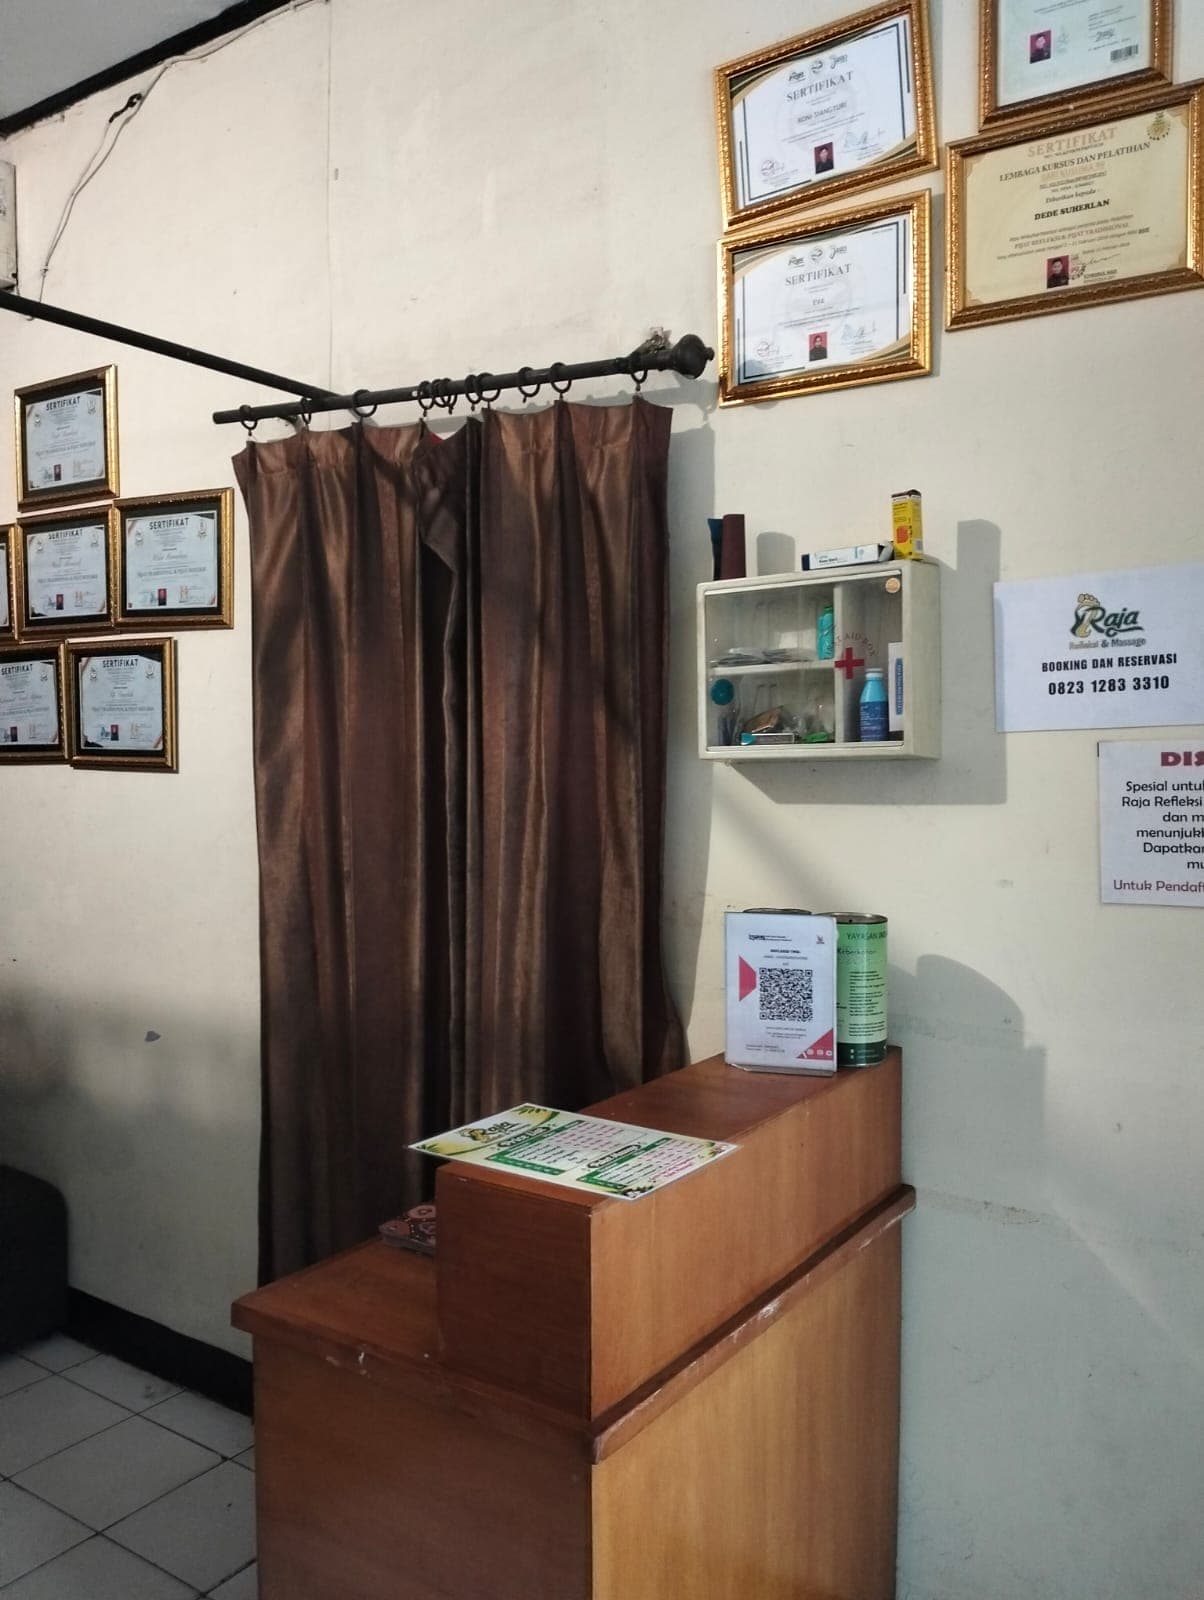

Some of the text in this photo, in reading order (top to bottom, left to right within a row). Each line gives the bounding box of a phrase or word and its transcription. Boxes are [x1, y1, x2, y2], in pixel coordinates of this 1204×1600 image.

[786, 71, 853, 102] SERTIFIKAT
[1027, 128, 1116, 158] SERTIFIKAT
[999, 166, 1041, 182] LEMBAGA
[1041, 157, 1076, 173] KURSUS
[1076, 153, 1097, 165] DAN
[1097, 141, 1152, 161] PELATIHAN
[1034, 198, 1111, 221] DEDE SUHERLAN
[785, 264, 851, 286] SERTIFIKAT
[46, 396, 81, 411] SERTIFIKAT
[149, 517, 190, 530] SERTIFIKAT
[48, 528, 83, 540] SERTIFIKAT
[1070, 606, 1144, 638] Raja
[1101, 640, 1109, 648] &
[1111, 638, 1147, 648] Massage
[1, 664, 33, 675] SERTIFIKAT
[103, 658, 139, 668] SERTIFIKAT
[1042, 653, 1177, 672] BOOKING DAN RESERVASI
[1048, 675, 1170, 695] 0823 1283 3310
[1126, 779, 1204, 793] Spesial untu
[1122, 796, 1202, 808] Raja Refleksi
[1162, 812, 1187, 822] dan
[1113, 879, 1152, 891] Untuk
